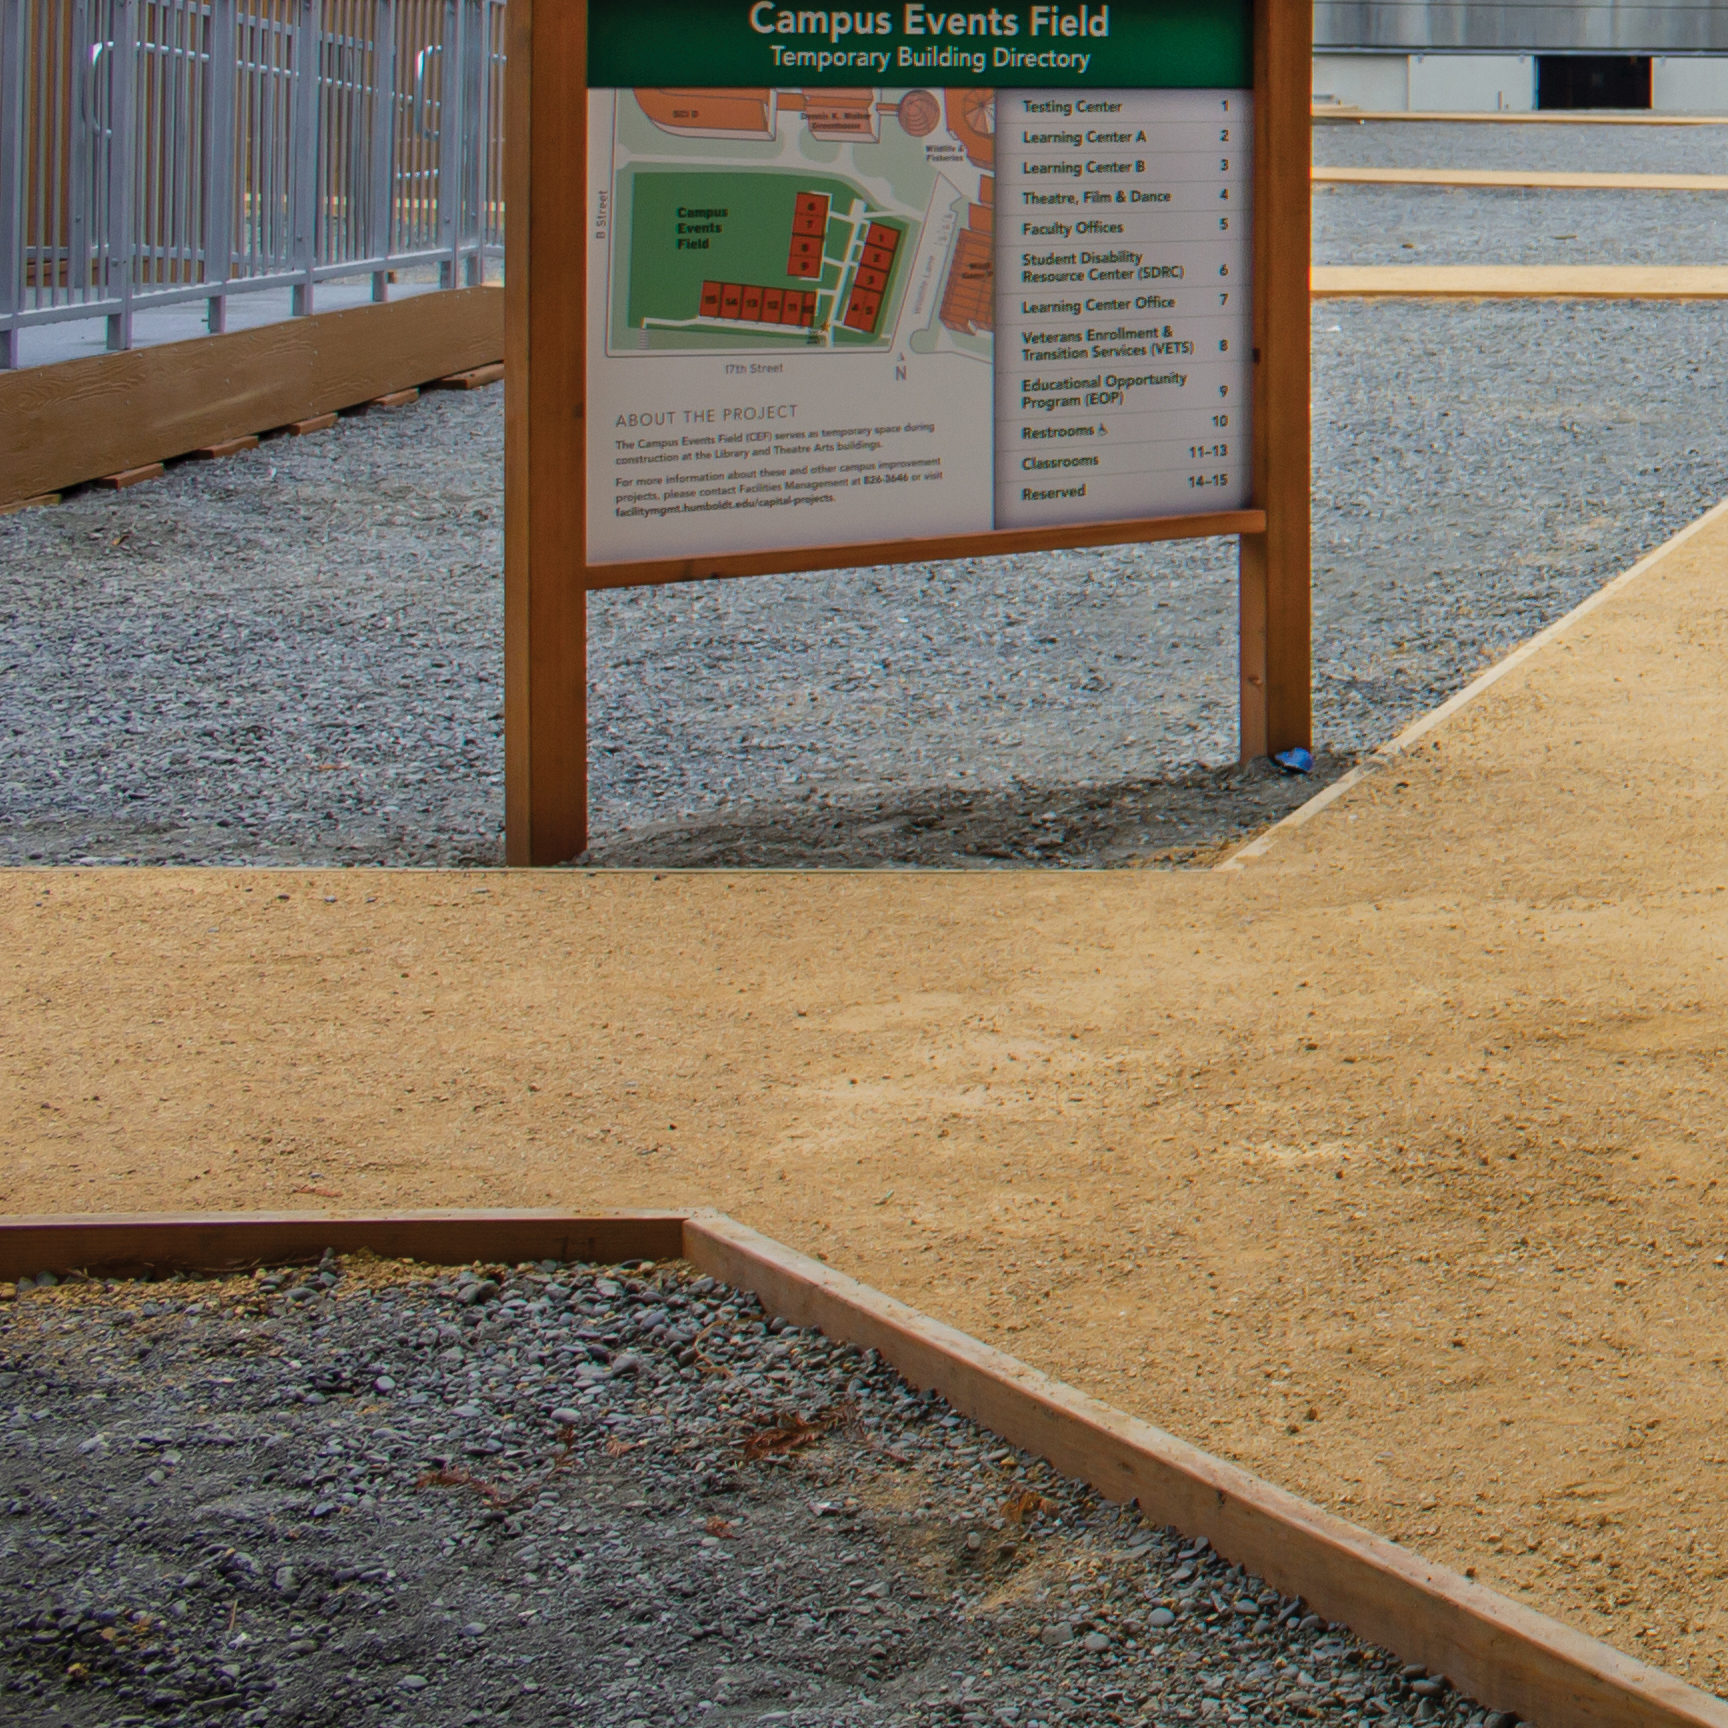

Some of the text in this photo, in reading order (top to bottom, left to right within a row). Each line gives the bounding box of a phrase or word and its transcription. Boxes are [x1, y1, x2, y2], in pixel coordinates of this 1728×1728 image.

[749, 0, 1110, 43] Campus Events Field
[770, 44, 1091, 74] Temporary Building Directory
[1022, 99, 1229, 116] Testing Center 1
[1022, 129, 1229, 147] Learning Center A 2
[1022, 159, 1229, 177] Learning Center B 3
[1022, 188, 1229, 205] Theatre, Film & Dance 4
[596, 190, 608, 227] Street
[676, 207, 728, 220] Campus
[676, 222, 723, 234] Events
[1022, 217, 1229, 238] Faculty Offices 5
[676, 238, 710, 250] Field
[1022, 250, 1143, 266] Student Disability
[1022, 265, 1185, 283] Resource Center (SDRC)
[1220, 264, 1229, 277] 6
[1022, 293, 1229, 315] Learning Center Office 7
[1022, 325, 1173, 345] Veterans Enrollment &
[1022, 341, 1195, 361] Transition Services (VETS)
[1220, 339, 1229, 352] 8
[725, 363, 784, 374] 17th Street
[895, 366, 907, 381] N
[1022, 372, 1188, 392] Educational Opportunity
[1220, 385, 1229, 398] 9
[1022, 391, 1124, 411] Program (EOP)
[615, 404, 798, 427] ABOUT THE PROJECT
[1022, 415, 1229, 439] Restrooms 10
[615, 440, 635, 450] The
[638, 438, 679, 449] Campus
[682, 436, 716, 446] Events
[718, 433, 743, 443] Field
[775, 431, 806, 440] serves
[808, 431, 819, 439] as
[820, 427, 872, 439] temporary
[873, 425, 902, 436] space
[904, 423, 935, 433] during
[615, 454, 679, 465] construction
[681, 452, 692, 461] at
[695, 450, 712, 460] the
[715, 449, 750, 459] Library
[752, 446, 770, 456] and
[774, 444, 811, 454] Theatre
[813, 443, 834, 452] Arts
[1022, 455, 1099, 470] Classrooms
[615, 457, 942, 487] For more information about these and other campus improvement
[664, 490, 696, 501] please
[699, 486, 736, 496] contact
[739, 483, 783, 494] Facilities
[784, 478, 849, 490] Management
[851, 478, 861, 486] at
[924, 471, 943, 481] visit
[1022, 484, 1087, 500] Reserved
